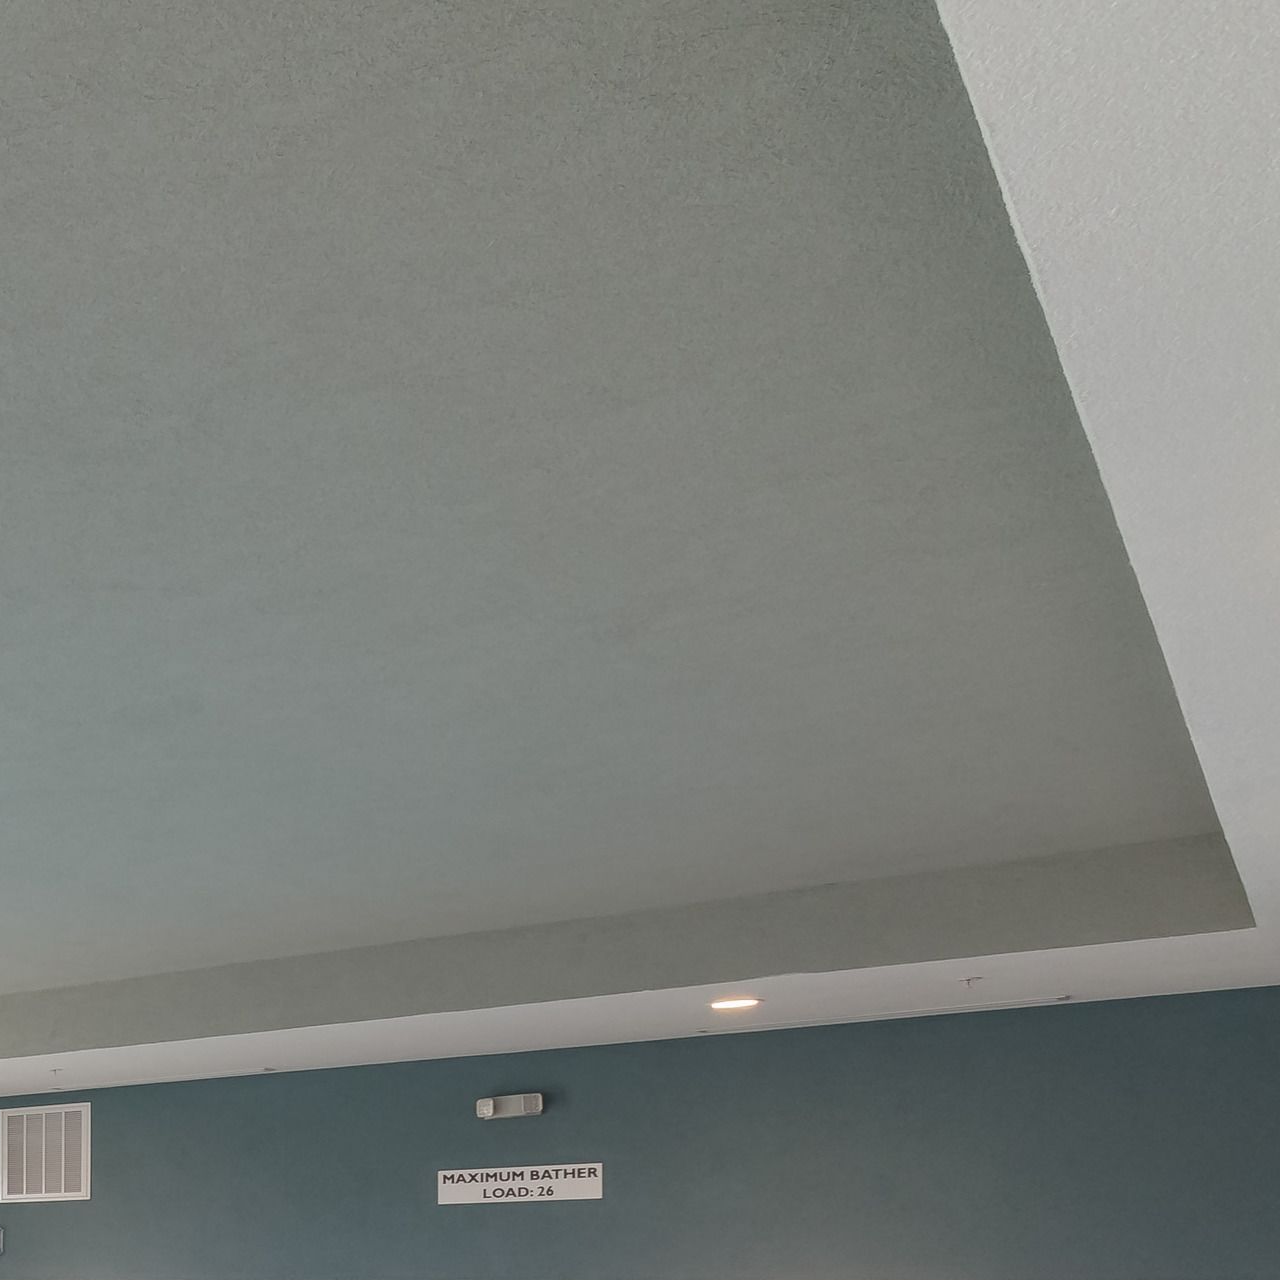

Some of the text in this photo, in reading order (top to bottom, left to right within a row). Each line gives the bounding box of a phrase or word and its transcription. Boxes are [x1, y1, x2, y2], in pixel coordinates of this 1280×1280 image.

[442, 1167, 598, 1184] MAXIMUM BATHER
[483, 1186, 554, 1199] LOAD: 26
